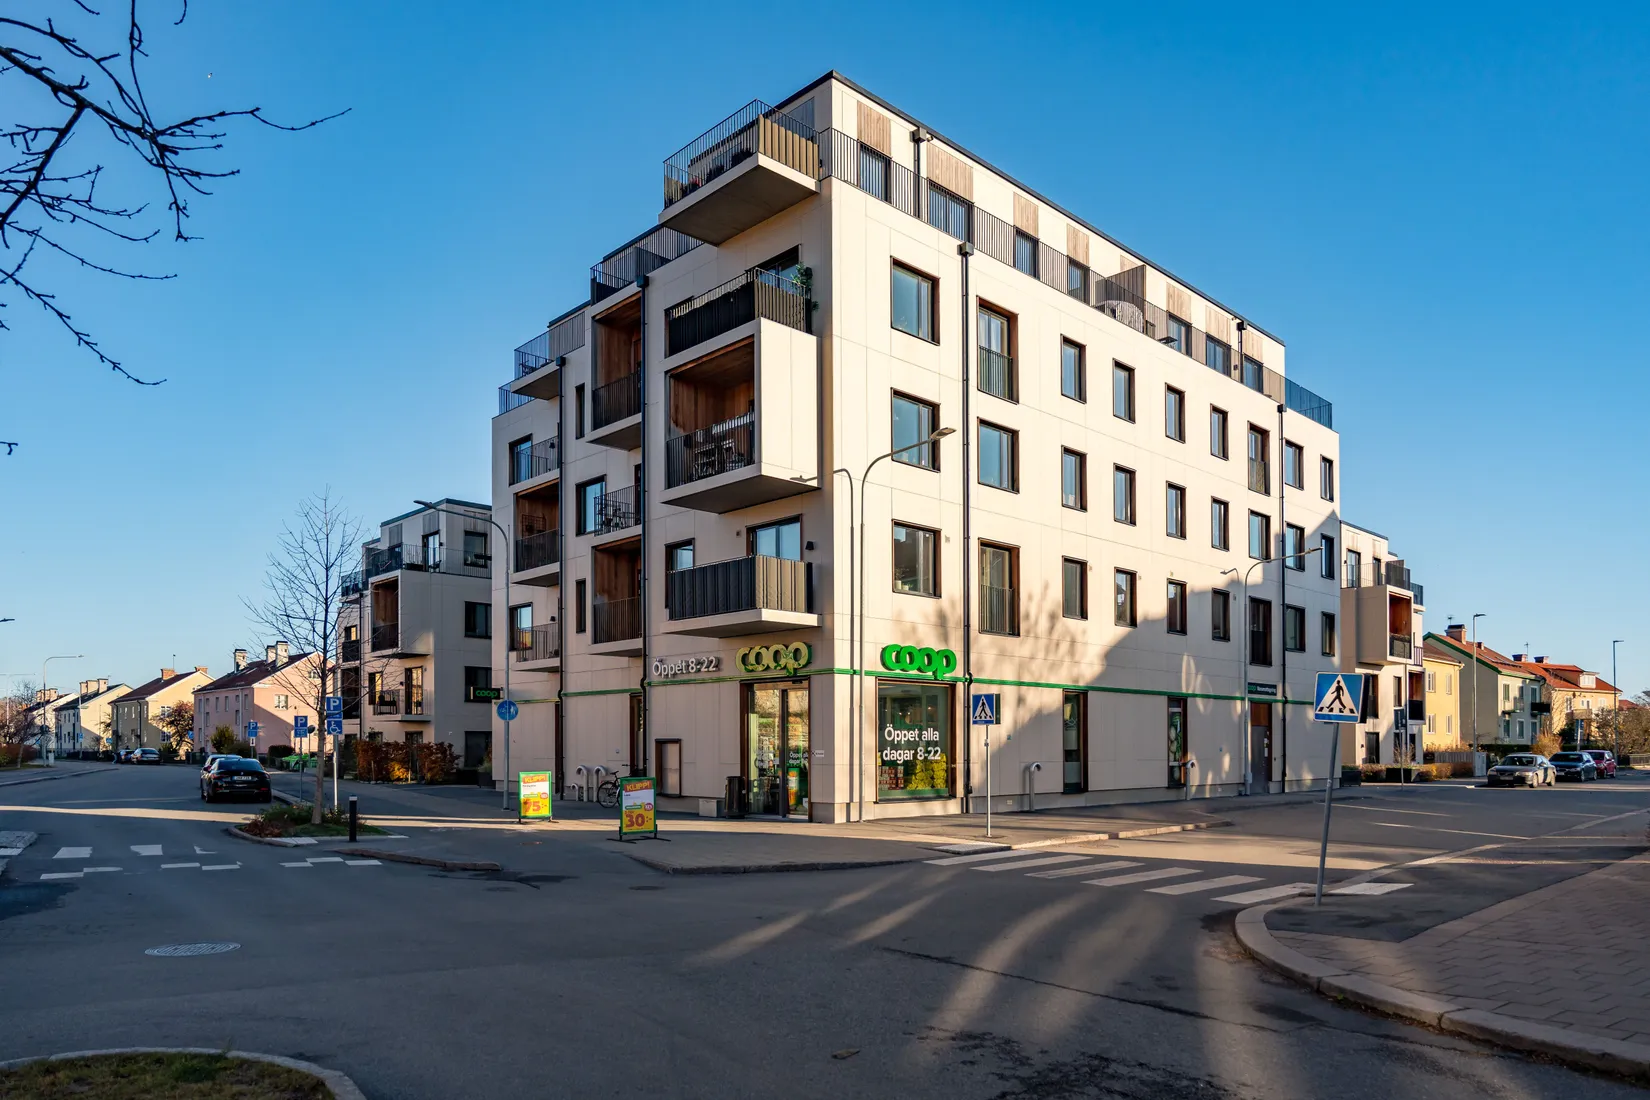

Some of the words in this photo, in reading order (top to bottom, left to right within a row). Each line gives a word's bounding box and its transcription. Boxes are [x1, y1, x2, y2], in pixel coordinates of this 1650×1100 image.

[736, 641, 811, 676] coop
[881, 644, 957, 680] coop
[653, 658, 687, 678] Öppet
[688, 656, 717, 673] 8-22
[476, 690, 498, 698] coop
[331, 699, 339, 711] P
[250, 722, 257, 730] P
[298, 717, 306, 727] P
[884, 724, 920, 744] Öppet
[921, 728, 940, 741] alla
[882, 747, 915, 764] dagar
[917, 747, 941, 760] 8-22
[626, 781, 651, 791] KLIPP!
[625, 813, 653, 828] 30:-
